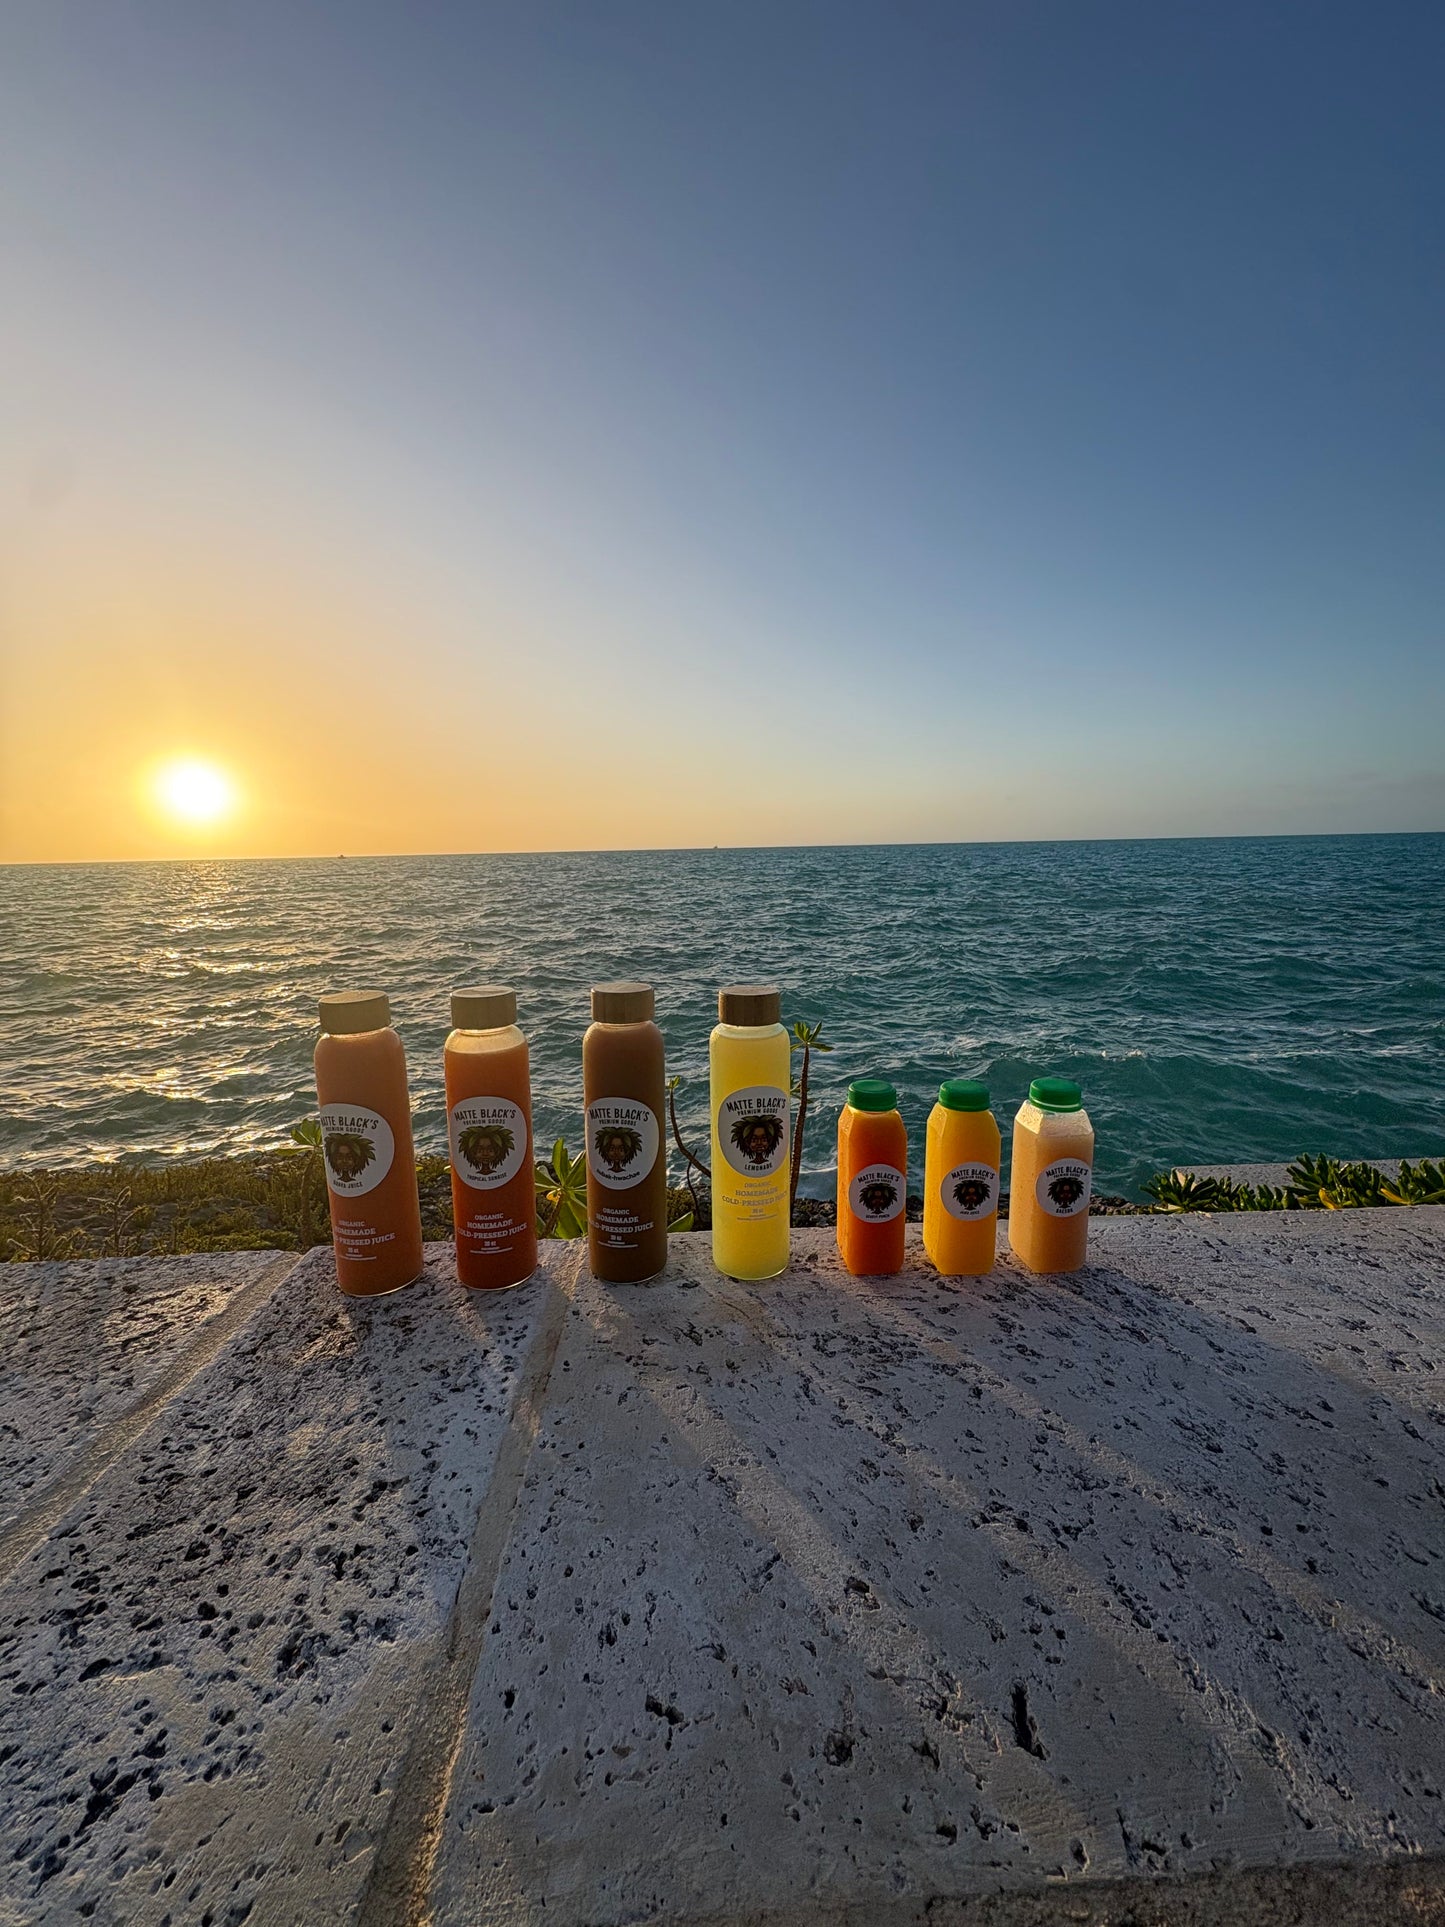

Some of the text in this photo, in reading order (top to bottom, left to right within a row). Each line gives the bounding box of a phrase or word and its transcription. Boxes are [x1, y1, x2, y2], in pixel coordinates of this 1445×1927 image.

[726, 1097, 786, 1112] MATTE BLACK'S
[454, 1109, 516, 1121] MATTE BLACK'S
[589, 1108, 650, 1122] MATTE BLACK'S
[338, 1116, 379, 1130] BLACK'S
[744, 1162, 772, 1171] LEMONADE
[1046, 1166, 1088, 1177] MATTE BLACK'S
[858, 1172, 900, 1183] MATTE BLACK'S
[951, 1169, 995, 1180] MATTE BLACK'S
[736, 1187, 778, 1197] HOMEMADE
[596, 1213, 640, 1224] HOMEMADE
[467, 1219, 513, 1230] HOMEMADE
[509, 1222, 528, 1236] JUICE
[634, 1221, 654, 1233] JUICE
[372, 1232, 396, 1245] JUICE
